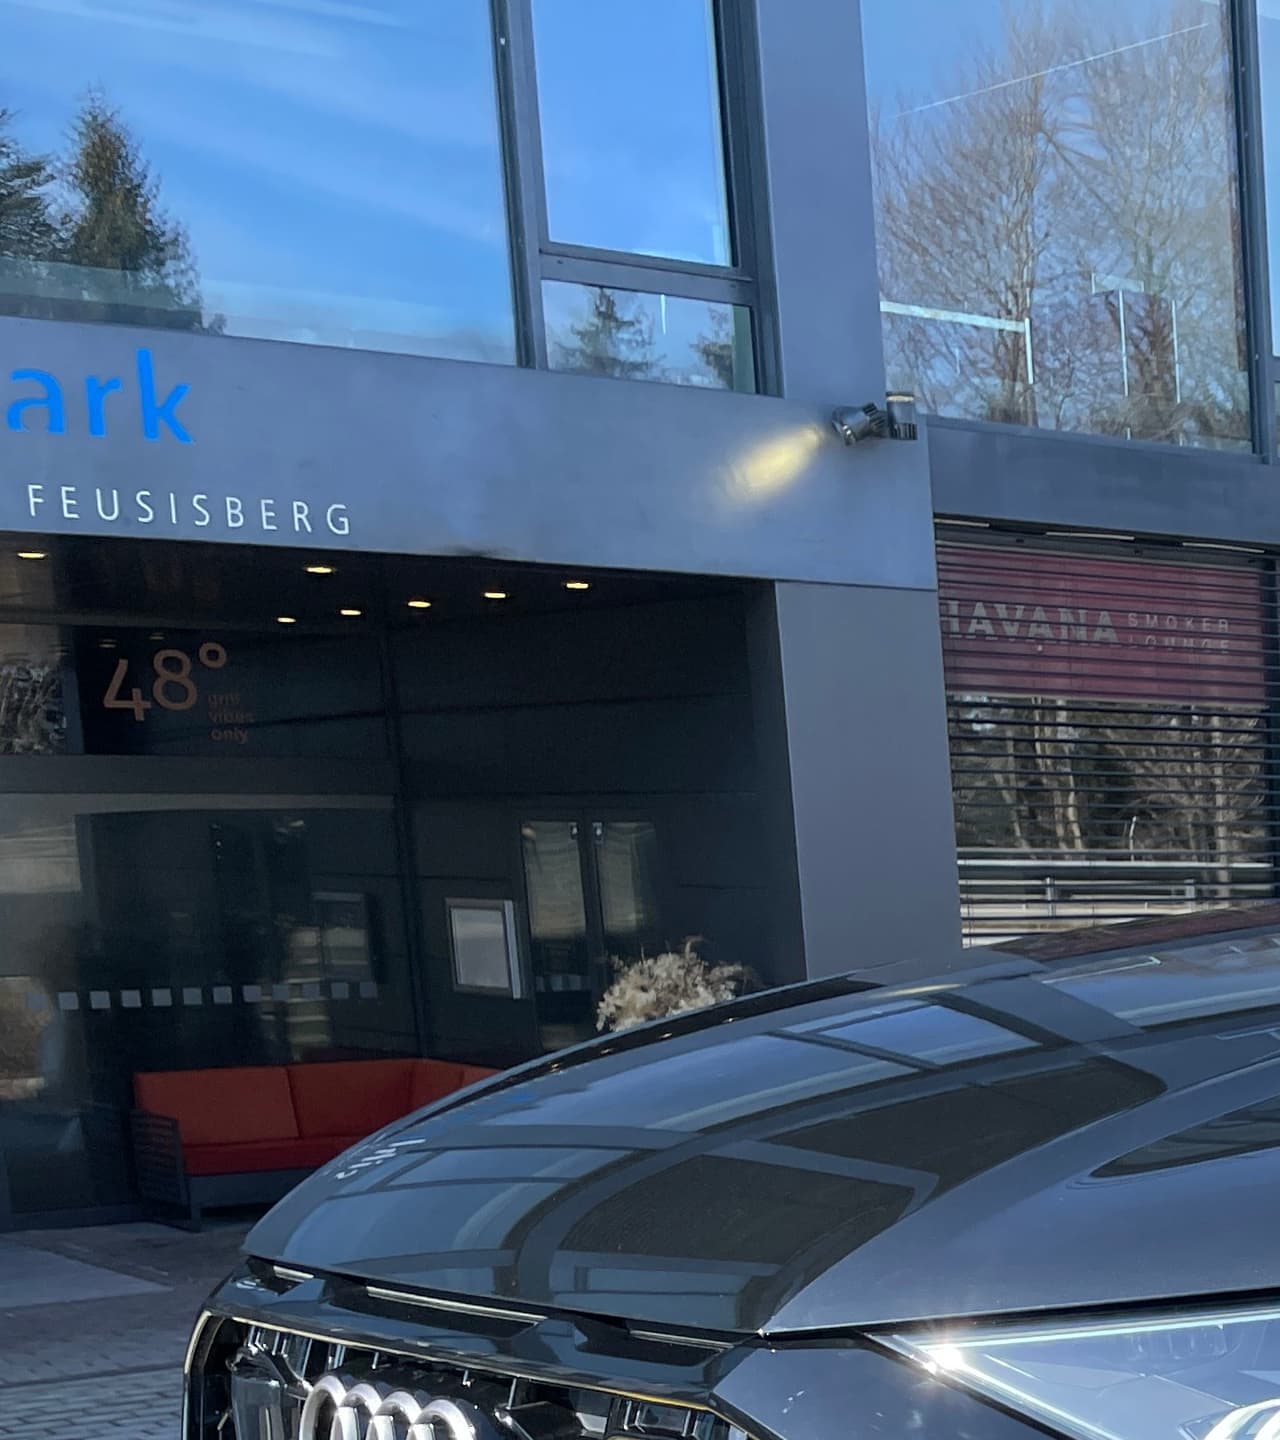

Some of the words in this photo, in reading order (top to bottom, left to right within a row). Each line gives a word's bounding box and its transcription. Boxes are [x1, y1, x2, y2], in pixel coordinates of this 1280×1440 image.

[5, 347, 195, 444] ark
[27, 484, 351, 536] FEUSISBERG
[941, 599, 1124, 648] HAVANA
[1128, 612, 1230, 632] SMOKER
[211, 728, 249, 744] only
